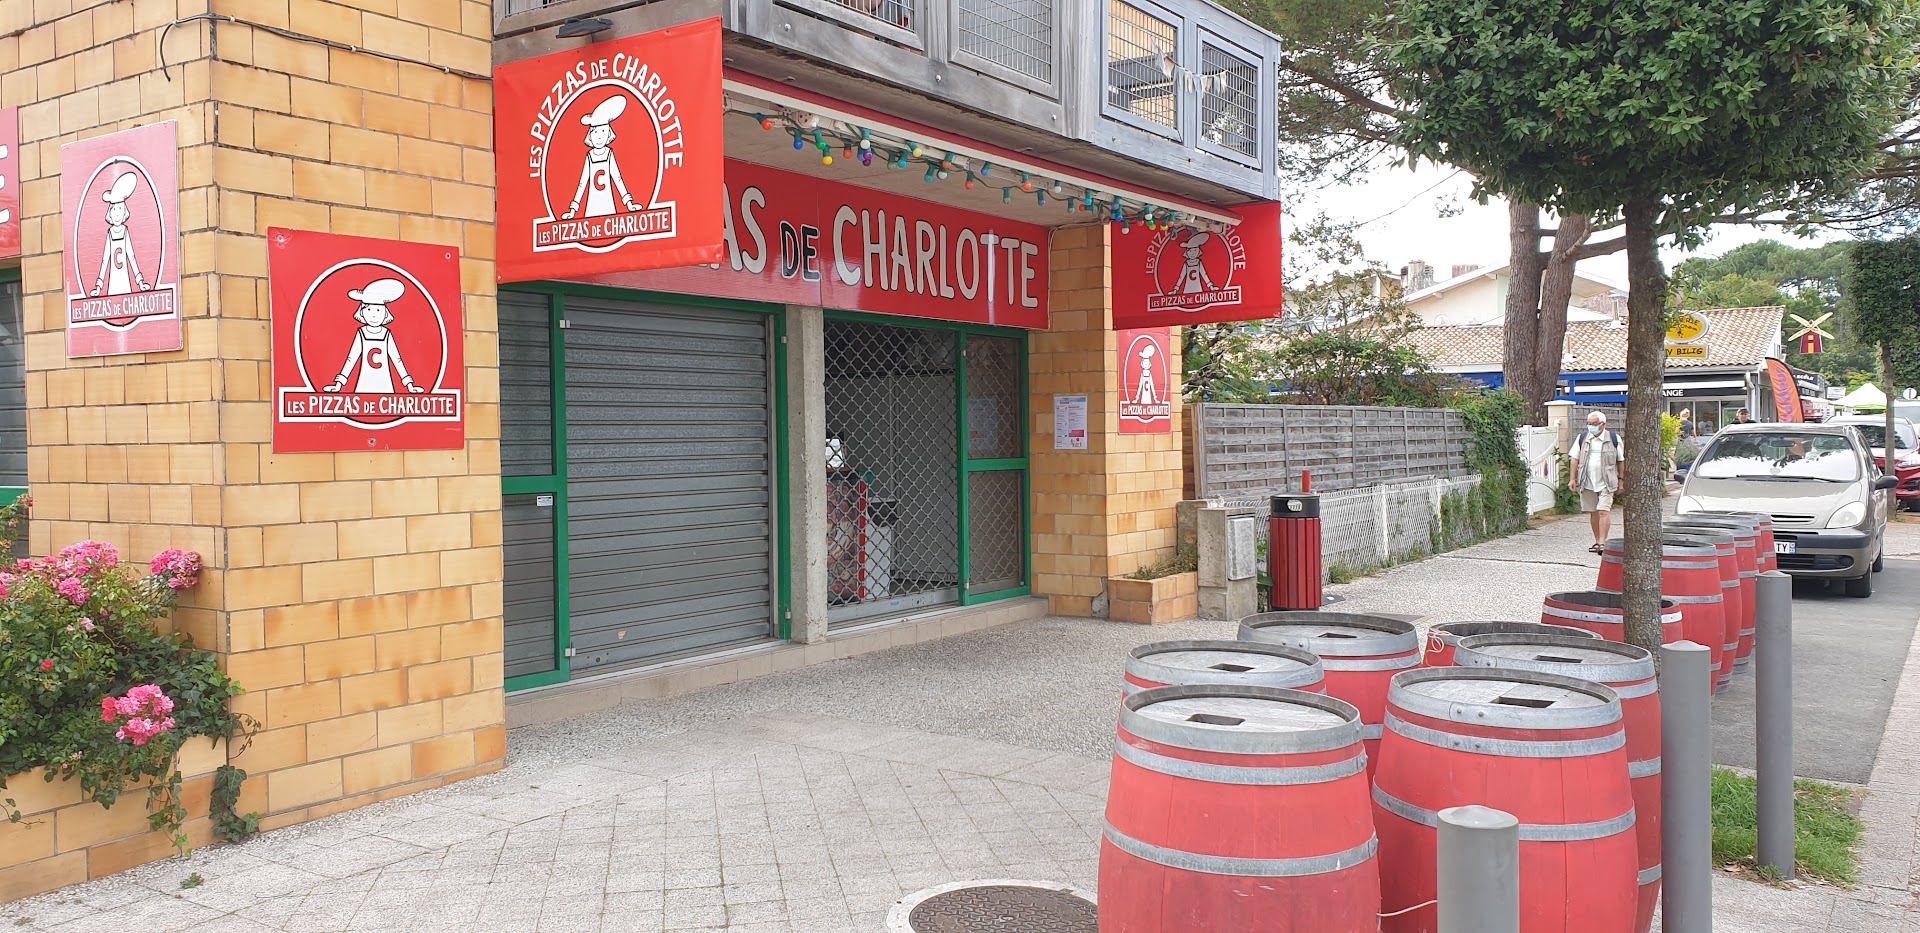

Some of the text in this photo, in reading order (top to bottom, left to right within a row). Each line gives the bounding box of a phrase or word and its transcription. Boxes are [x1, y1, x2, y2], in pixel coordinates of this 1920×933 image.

[530, 53, 684, 178] LES PIZZAS DE CHARLOTTE
[593, 169, 606, 191] C
[539, 212, 669, 244] LES PIZZAS DE CHARLOTTE
[711, 182, 1039, 308] AS DE CHARLOTTE
[114, 247, 123, 269] C
[1146, 256, 1155, 274] LES
[1189, 270, 1197, 281] C
[72, 293, 172, 319] LES PIZZAS DE CHARLOTTE
[1161, 295, 1186, 306] PIZZAS
[1195, 291, 1237, 303] CHARLOTTE
[367, 347, 382, 369] C
[287, 396, 454, 414] LES PIZZAS DE CHARLOTTE
[1147, 405, 1168, 415] CHARLOTTE
